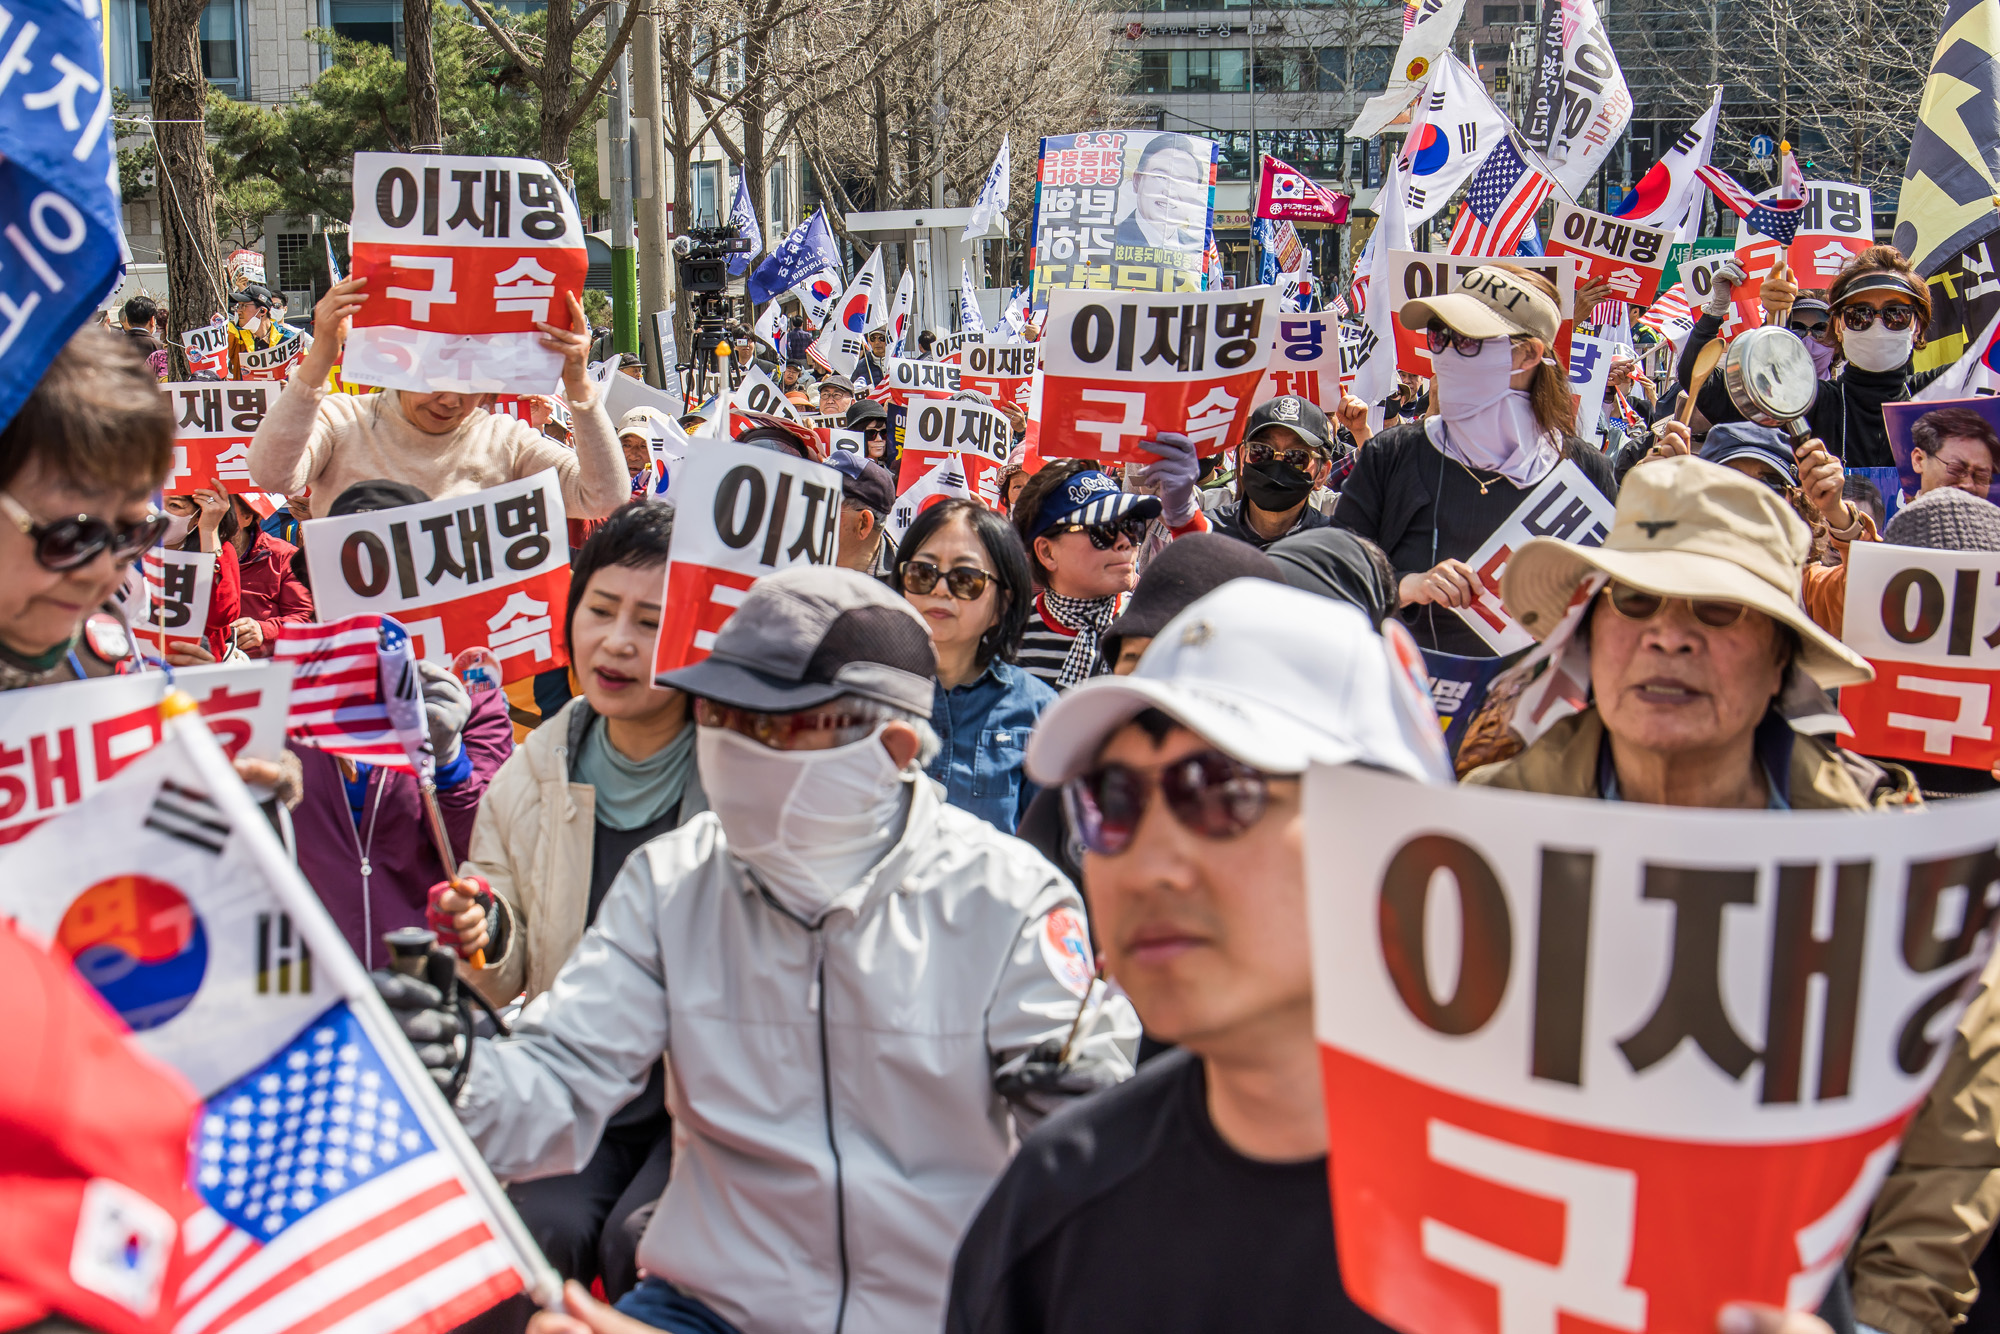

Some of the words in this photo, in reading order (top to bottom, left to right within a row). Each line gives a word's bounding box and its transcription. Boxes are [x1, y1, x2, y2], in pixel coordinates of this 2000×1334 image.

[375, 166, 567, 241] 이재명
[1564, 211, 1664, 263] 이재명
[385, 254, 557, 323] 구속
[191, 325, 228, 352] 이재
[246, 334, 301, 368] 이재명
[969, 346, 1036, 376] 이재명
[1070, 298, 1266, 373] 이재명
[897, 362, 960, 392] 이재명
[919, 406, 1008, 461] 이재명
[1075, 386, 1240, 453] 구속
[340, 486, 552, 601] 이재명
[714, 464, 843, 568] 이재
[1880, 567, 2000, 657] 이
[1886, 673, 1994, 757] 구
[1376, 828, 2000, 1110] 이재명
